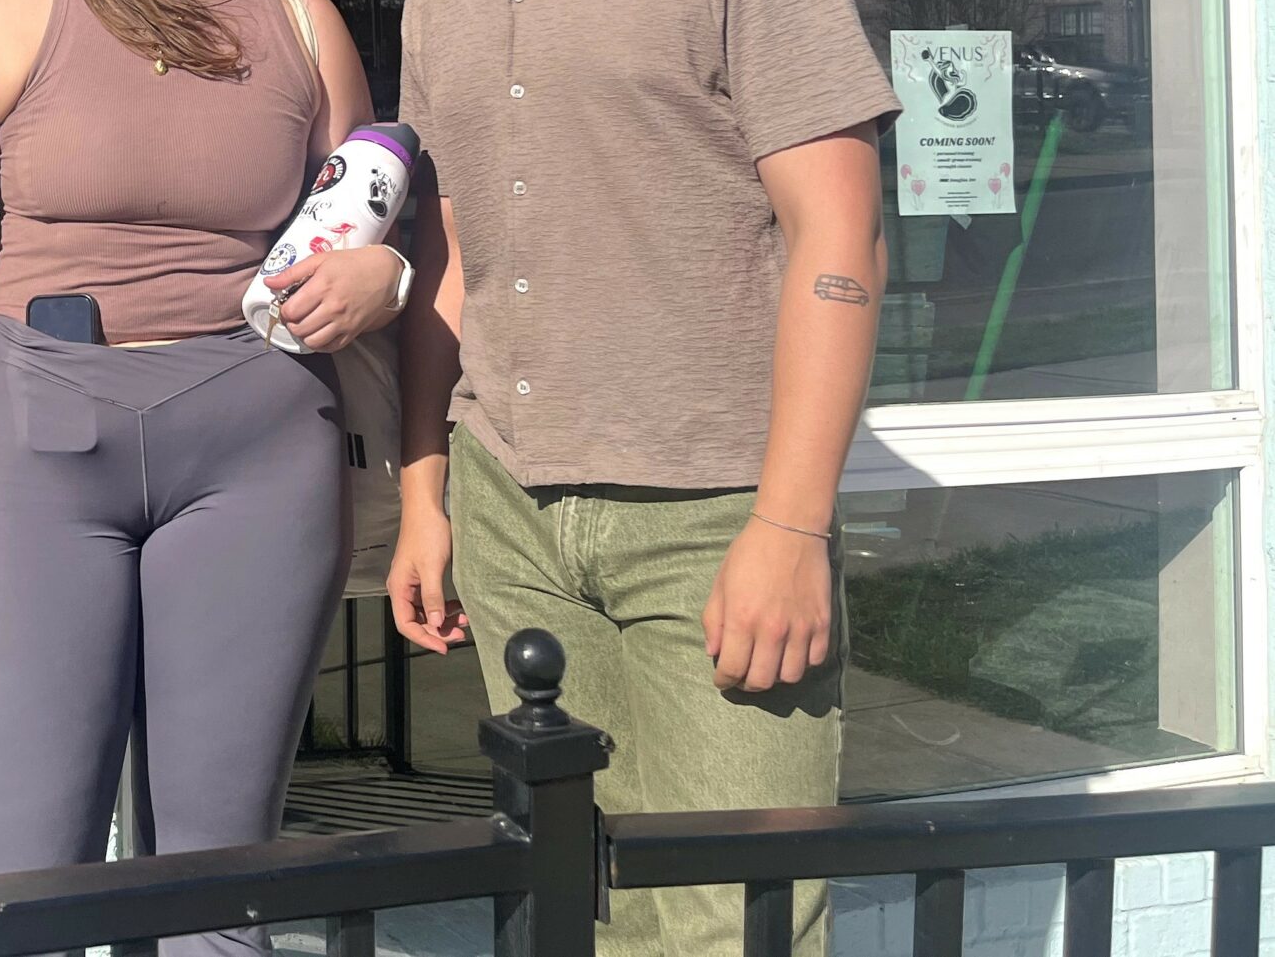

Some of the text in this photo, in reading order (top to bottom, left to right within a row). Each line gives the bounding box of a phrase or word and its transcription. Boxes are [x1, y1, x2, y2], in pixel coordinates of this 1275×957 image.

[926, 46, 983, 62] VENUS
[919, 136, 996, 147] COMING SOON!
